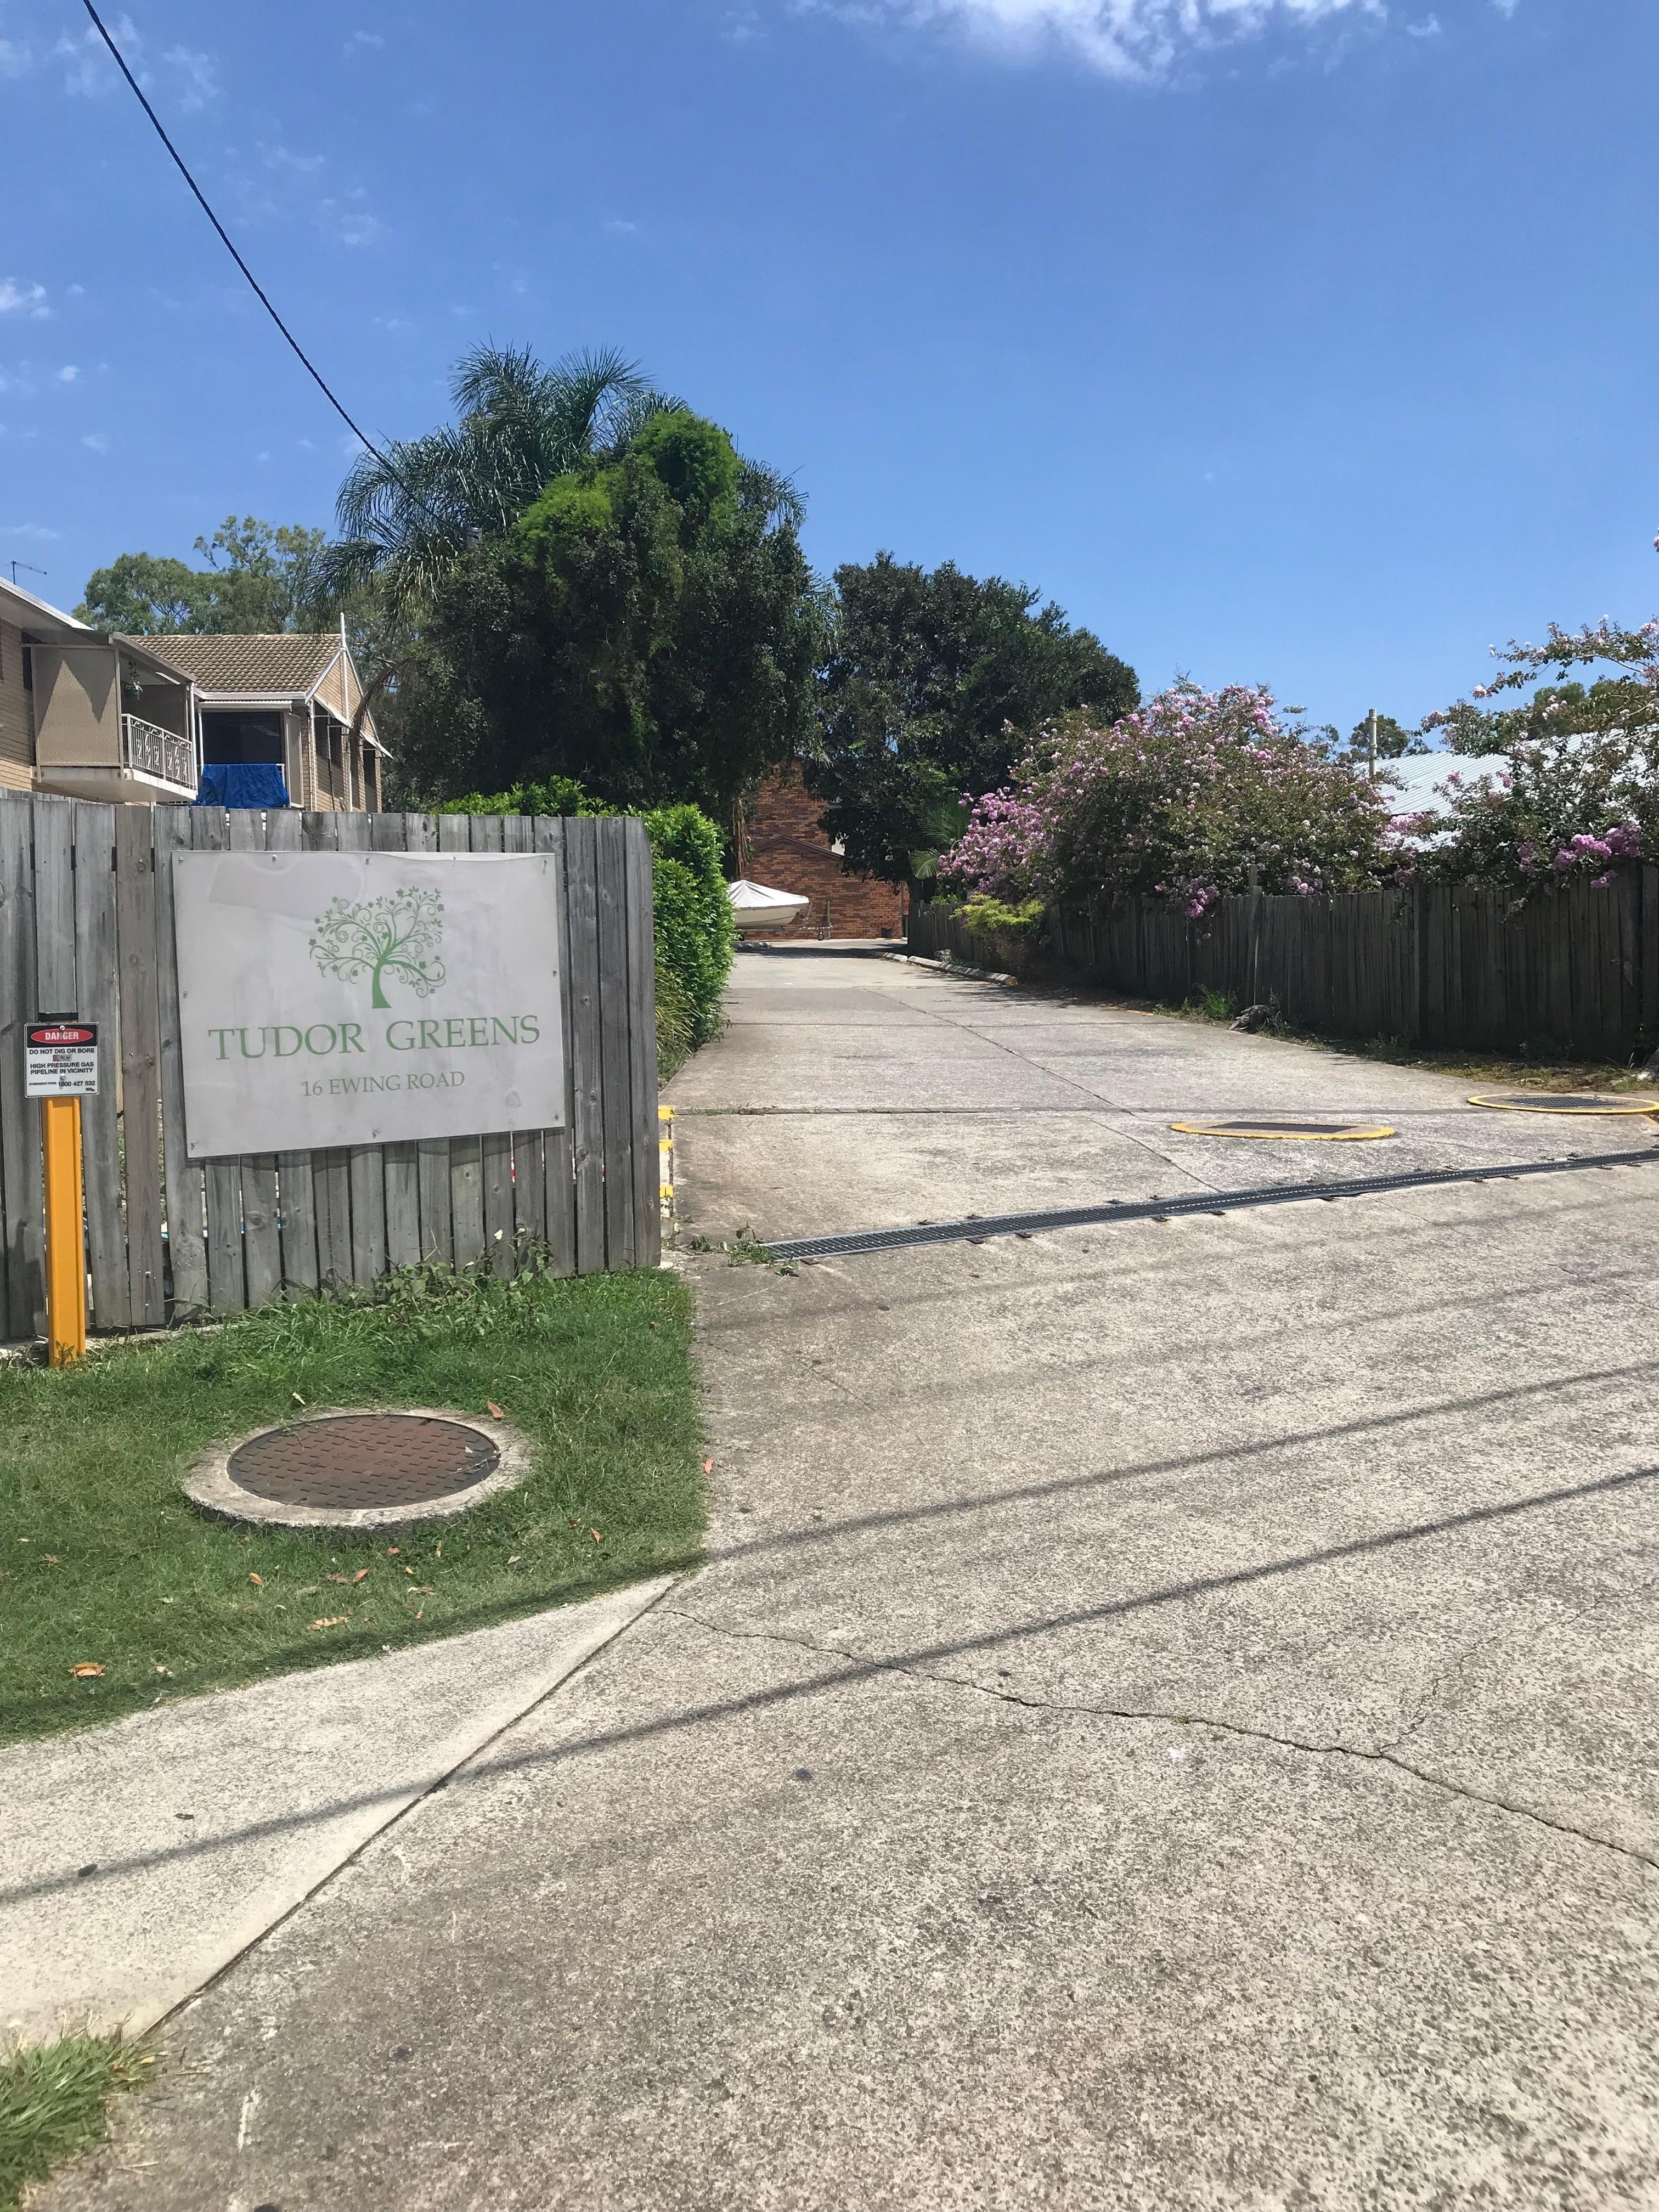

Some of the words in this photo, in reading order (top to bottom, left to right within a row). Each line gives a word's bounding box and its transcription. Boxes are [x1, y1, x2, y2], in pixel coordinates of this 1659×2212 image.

[45, 1031, 79, 1040] DANGER
[208, 1023, 365, 1060] TUDOR
[386, 1015, 540, 1051] GREENS
[301, 1080, 323, 1096] 16
[328, 1075, 400, 1094] EWING
[408, 1071, 465, 1090] ROAD
